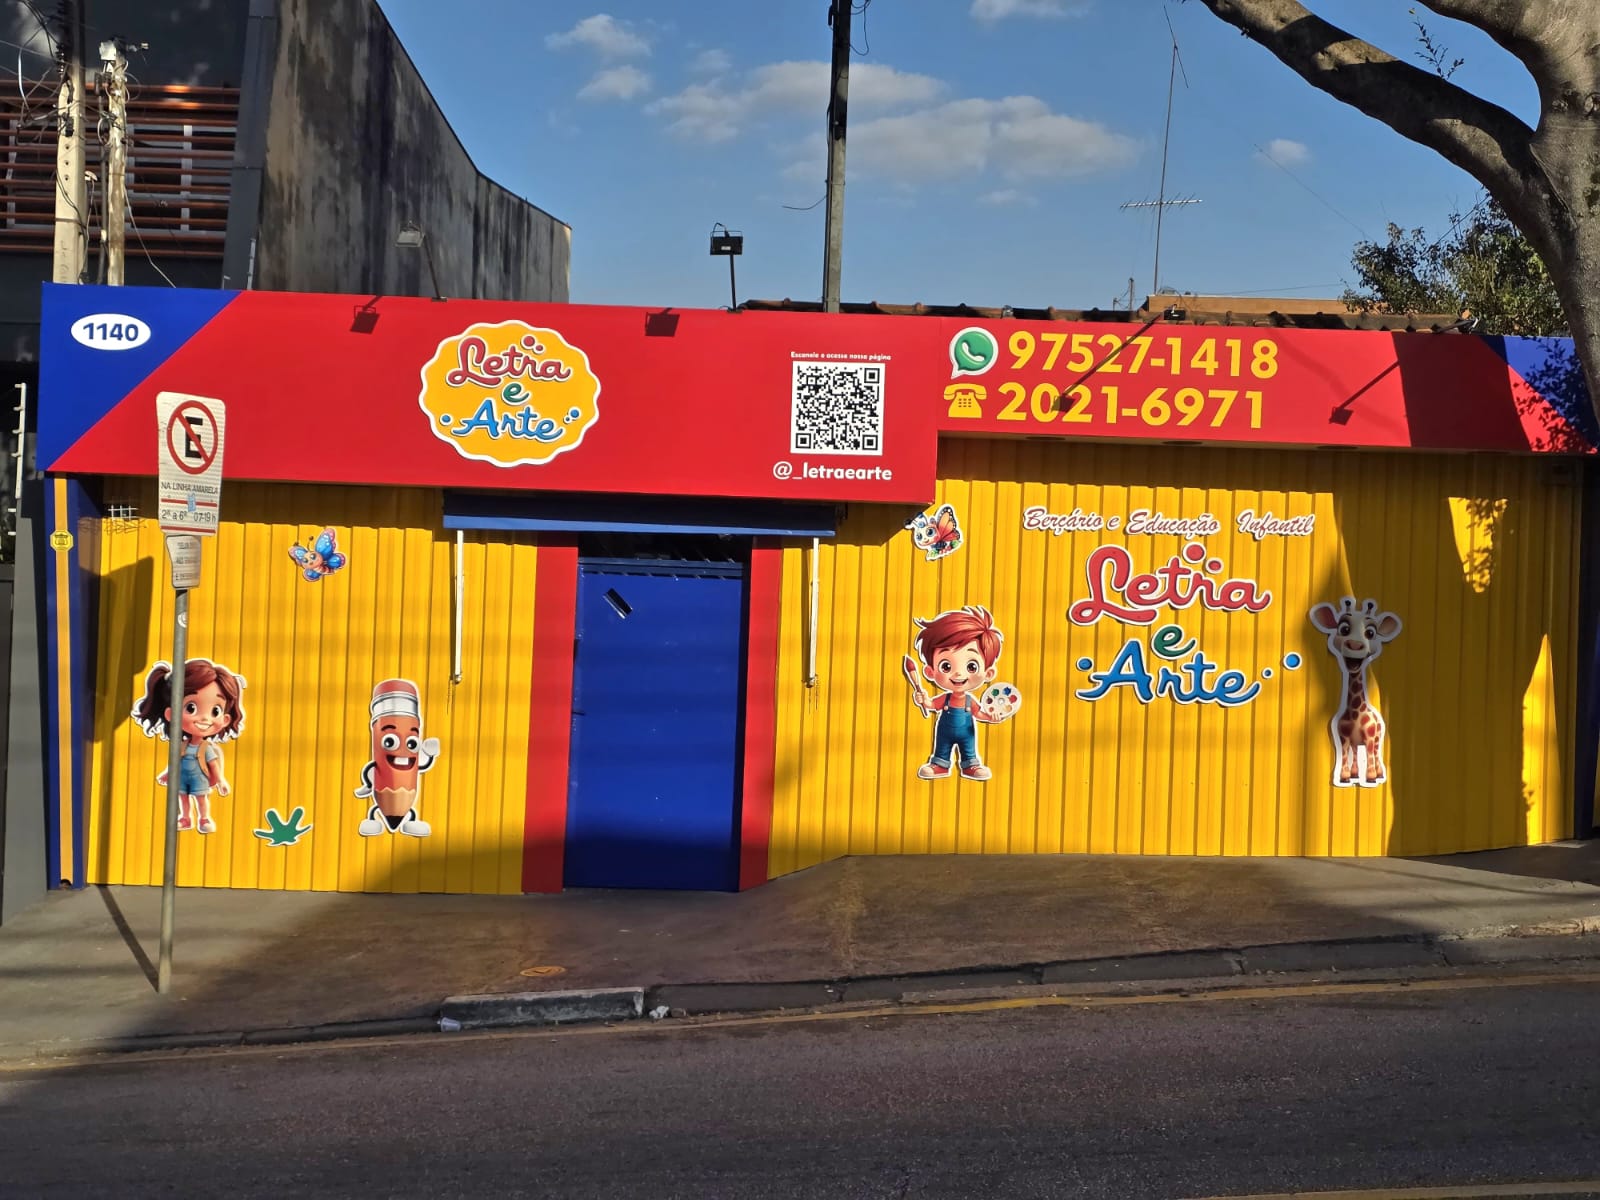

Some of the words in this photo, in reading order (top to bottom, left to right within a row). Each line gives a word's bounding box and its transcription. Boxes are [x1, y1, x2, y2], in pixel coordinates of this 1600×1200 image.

[83, 323, 139, 342] 1140
[447, 336, 571, 386] Letra
[1008, 330, 1278, 379] 97527-1418
[502, 382, 530, 403] e
[996, 382, 1264, 429] 2021-6971
[451, 399, 564, 441] Arte
[161, 482, 171, 490] NA
[172, 482, 191, 491] LINHA
[192, 485, 218, 494] AMARELA
[773, 461, 892, 481] @_letraearte
[1023, 506, 1103, 535] Berçário
[1106, 514, 1120, 529] e
[1126, 510, 1220, 539] Educação
[1236, 509, 1315, 540] Infantil
[1068, 544, 1272, 625] Letra
[1152, 623, 1197, 659] e
[1075, 638, 1261, 705] Arte
